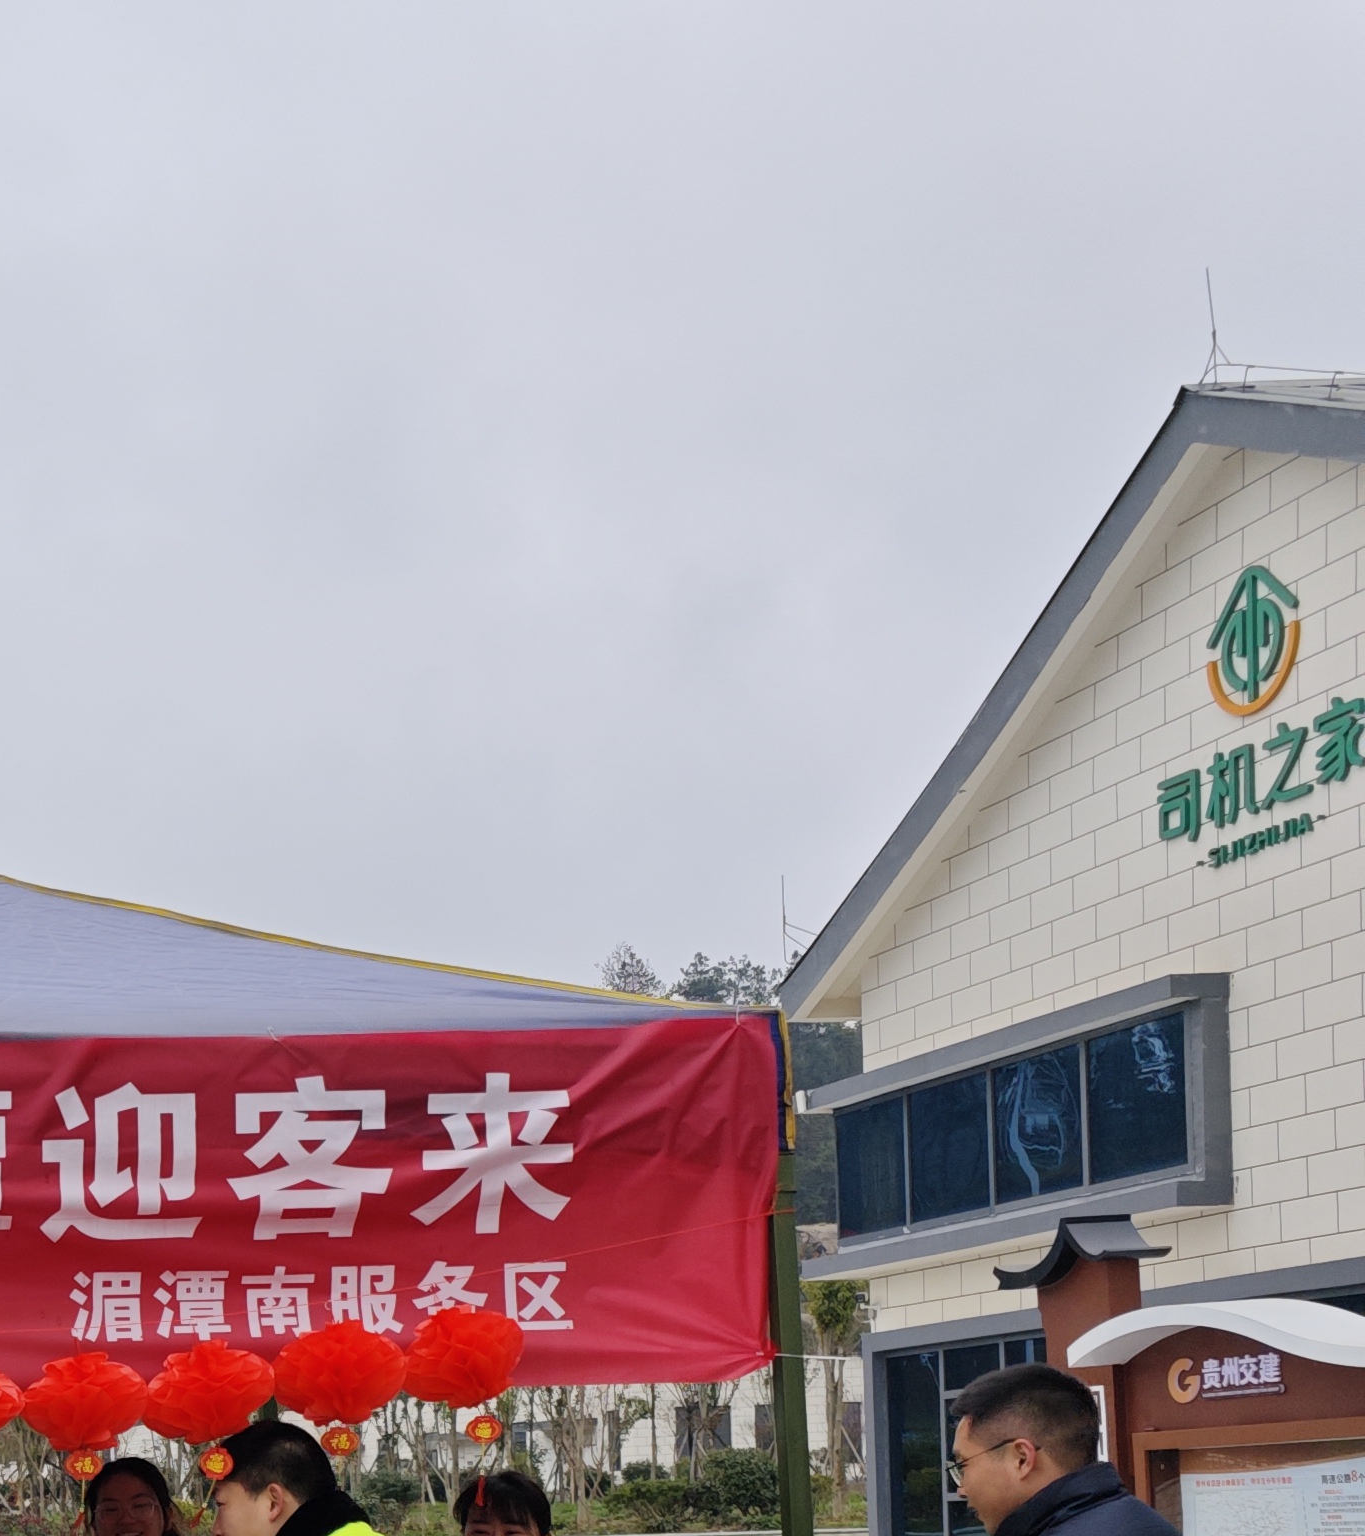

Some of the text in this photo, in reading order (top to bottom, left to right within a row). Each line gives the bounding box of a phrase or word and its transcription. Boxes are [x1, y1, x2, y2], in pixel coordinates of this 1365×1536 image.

[1157, 697, 1365, 842] 司机之家
[1207, 812, 1315, 869] SIJIZHIJIA
[68, 1260, 575, 1342] 湄潭南服务区
[1201, 1352, 1281, 1390] 贵州交建
[330, 1432, 350, 1451] 福
[73, 1456, 95, 1475] 福
